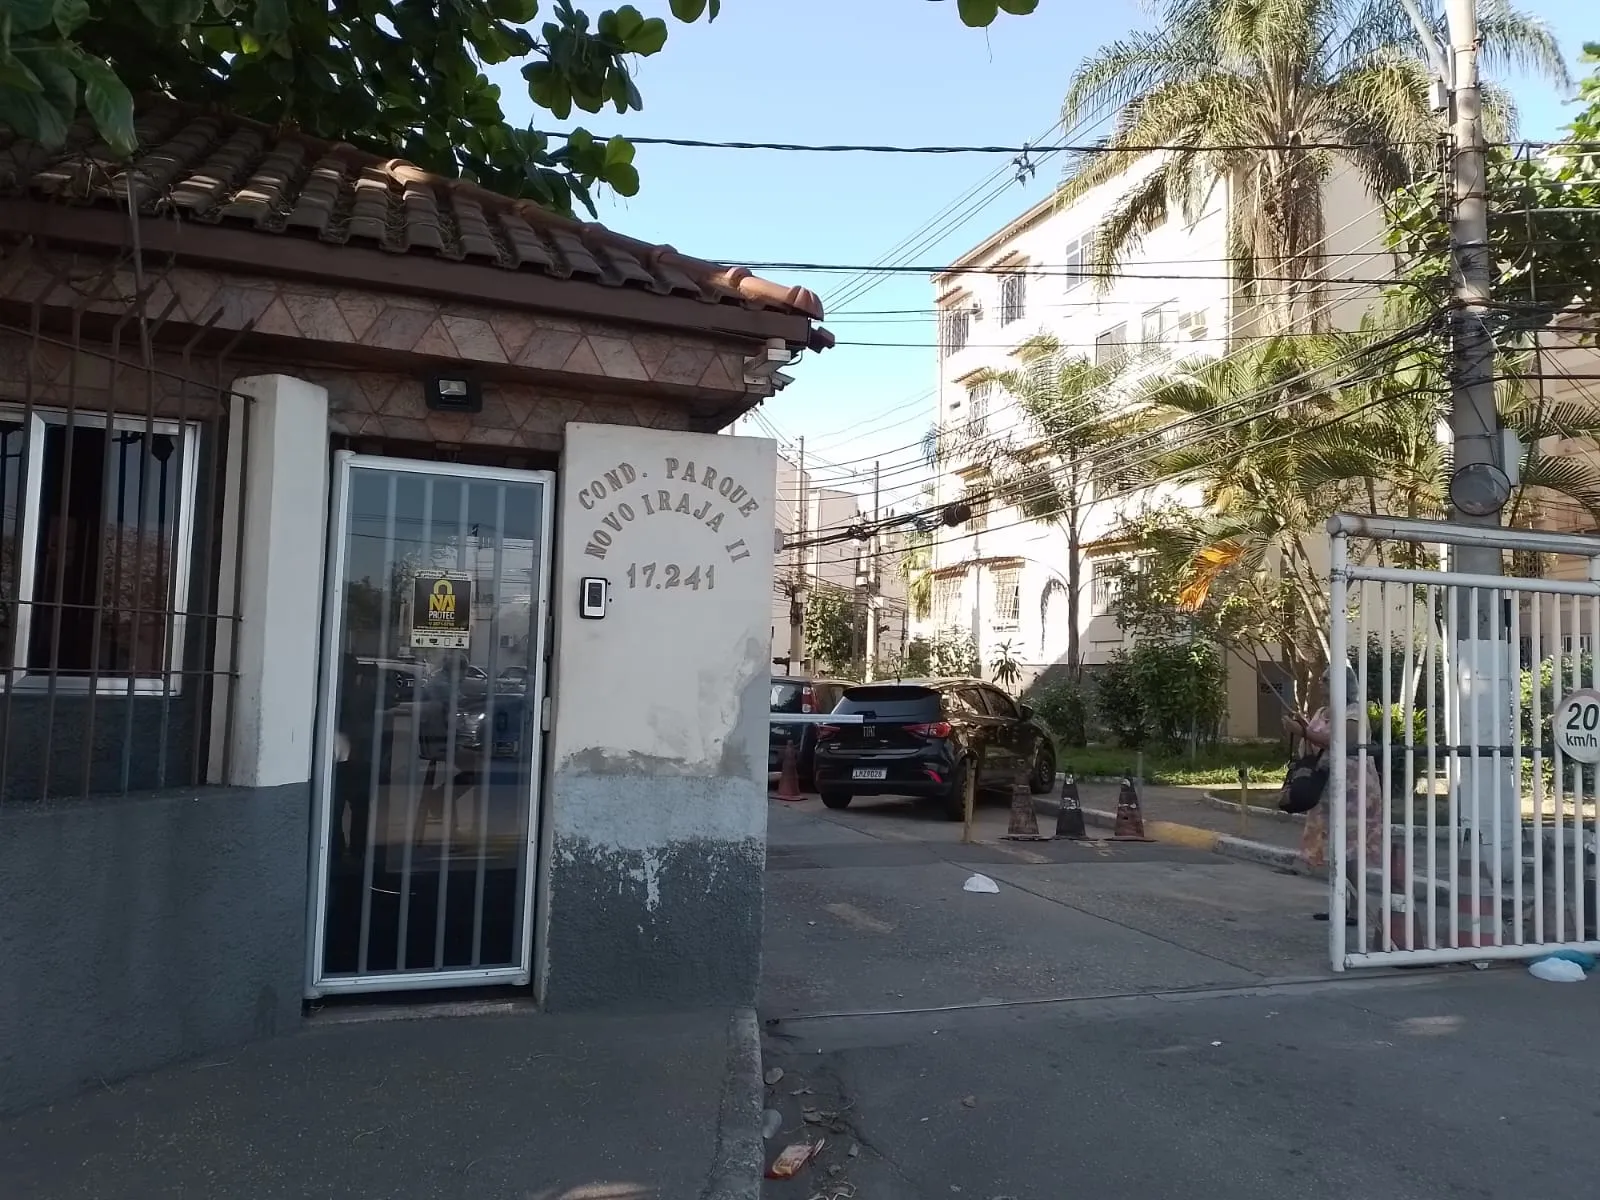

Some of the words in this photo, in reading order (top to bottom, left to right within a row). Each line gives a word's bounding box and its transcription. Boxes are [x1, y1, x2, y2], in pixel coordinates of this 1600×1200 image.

[578, 462, 648, 510] COND.
[665, 457, 760, 518] PARQUE
[584, 503, 635, 560] NOVO
[641, 490, 725, 533] IRAJA
[725, 538, 751, 563] II
[626, 562, 715, 591] 17.241
[428, 611, 455, 620] PROTEC
[1566, 702, 1599, 731] 20
[1565, 732, 1598, 748] km/h
